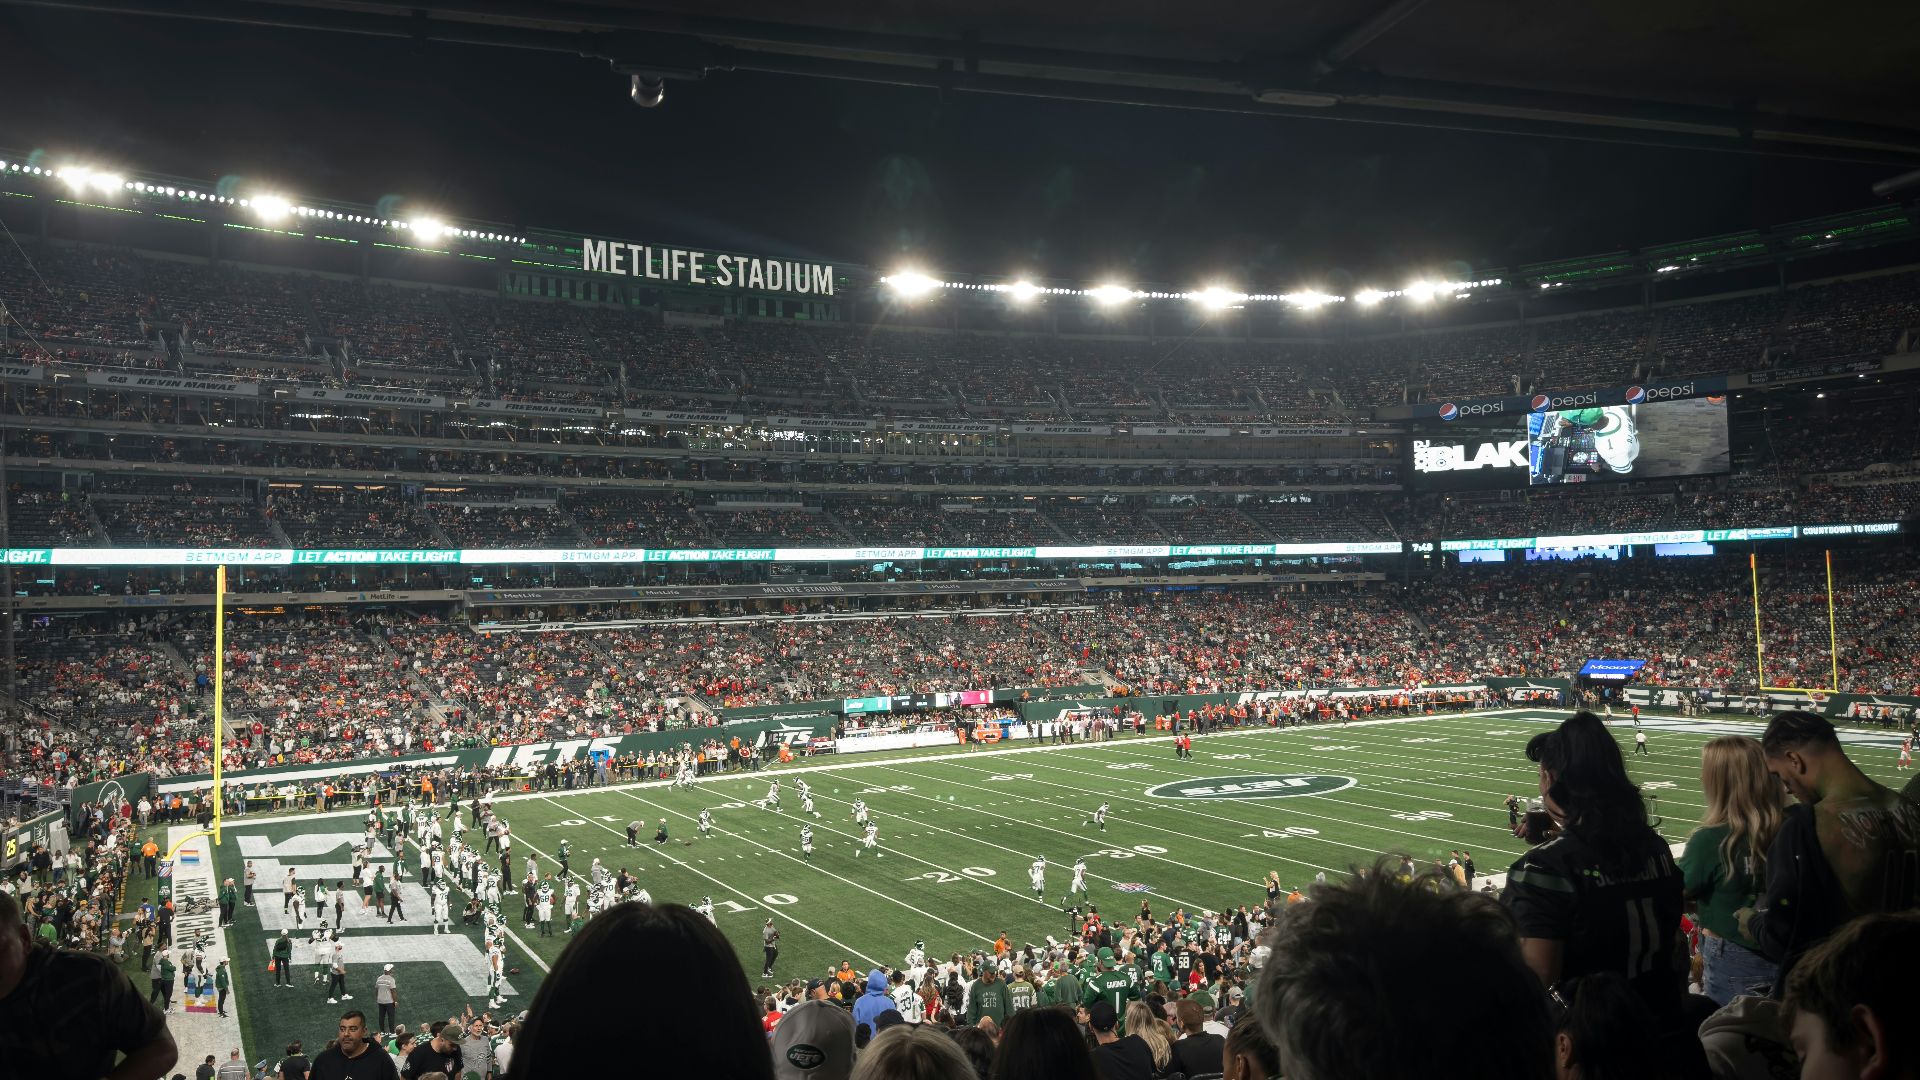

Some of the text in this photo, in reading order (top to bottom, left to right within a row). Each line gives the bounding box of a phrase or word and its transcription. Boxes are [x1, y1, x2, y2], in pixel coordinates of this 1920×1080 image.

[583, 238, 834, 296] METLIFE STADIUM
[136, 377, 181, 388] KEVIN
[184, 380, 237, 391] MAWAE
[312, 390, 431, 404] 13 DON MAYNARD
[1646, 382, 1694, 402] pepsi
[1551, 392, 1597, 409] pepsi
[505, 404, 559, 414] FREEMAN
[560, 405, 597, 415] MCNEIL
[1460, 401, 1504, 417] pepsi
[683, 413, 728, 421] NAMATH
[1802, 524, 1852, 535] COUNTDOWN
[1853, 525, 1863, 534] TO
[1865, 523, 1899, 532] KICKOFF
[1707, 531, 1728, 540] LET
[1172, 546, 1188, 555] LET
[1187, 546, 1222, 555] ACTION
[1223, 546, 1243, 555] TAKE
[1471, 540, 1496, 550] TAKE
[185, 552, 249, 562] BETMGM
[298, 551, 323, 561] LET
[322, 551, 376, 561] ACTION
[378, 551, 409, 560] TAKE
[411, 551, 457, 561] FLIGHT.
[562, 551, 610, 560] BETMGM
[648, 550, 668, 560] LET
[669, 550, 710, 560] ACTION
[711, 550, 735, 560] TAKE
[736, 550, 773, 560] FLIGHT.
[855, 550, 896, 558] BETMGM
[926, 549, 942, 558] LET
[943, 549, 979, 558] ACTION
[980, 548, 1001, 558] TAKE
[1001, 548, 1033, 558] FLIGHT.
[1389, 811, 1453, 821] 50
[1262, 826, 1320, 839] 40
[5, 838, 17, 859] 25
[1096, 845, 1160, 857] 30
[922, 866, 997, 883] 20
[714, 893, 799, 913] 10
[1626, 897, 1661, 979] 11
[900, 996, 912, 1012] 33
[982, 997, 997, 1008] JETS
